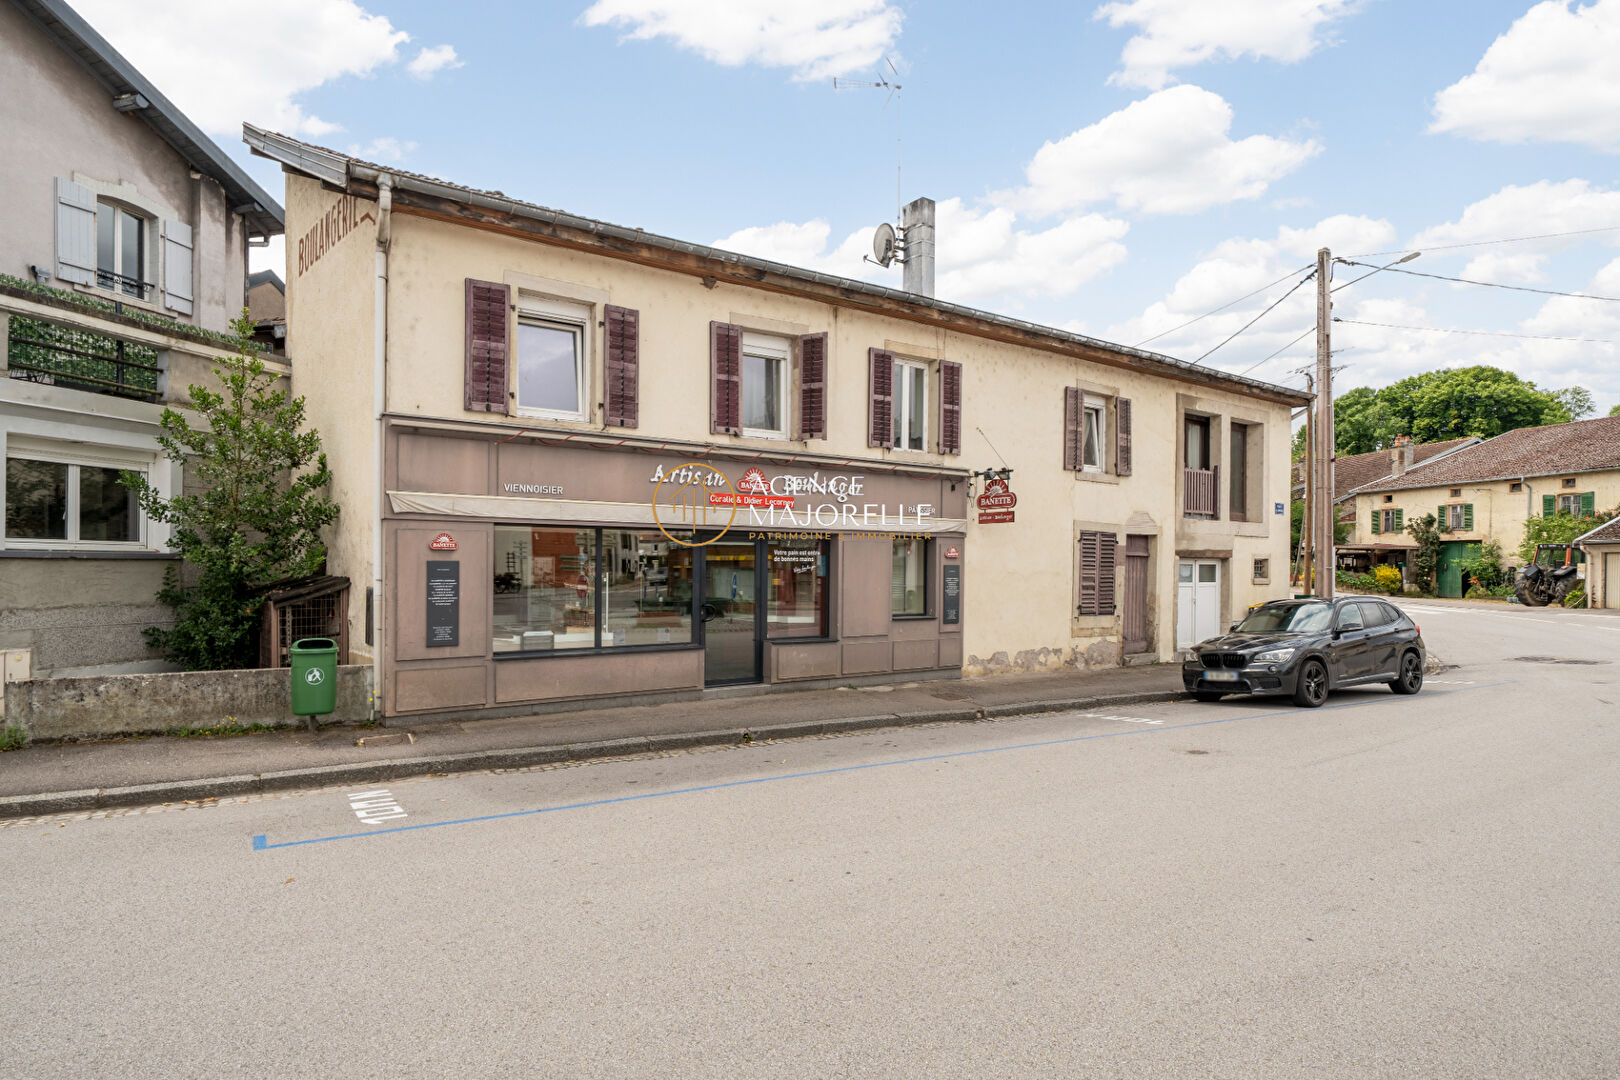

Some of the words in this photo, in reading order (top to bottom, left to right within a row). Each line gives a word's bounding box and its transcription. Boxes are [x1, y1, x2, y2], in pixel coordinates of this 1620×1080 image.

[299, 193, 359, 277] BOULANGERIE
[650, 464, 726, 486] Artisan
[503, 483, 564, 495] VIENNOISIER
[736, 496, 742, 504] &
[743, 497, 762, 505] Didier
[980, 497, 1011, 506] BANETTE
